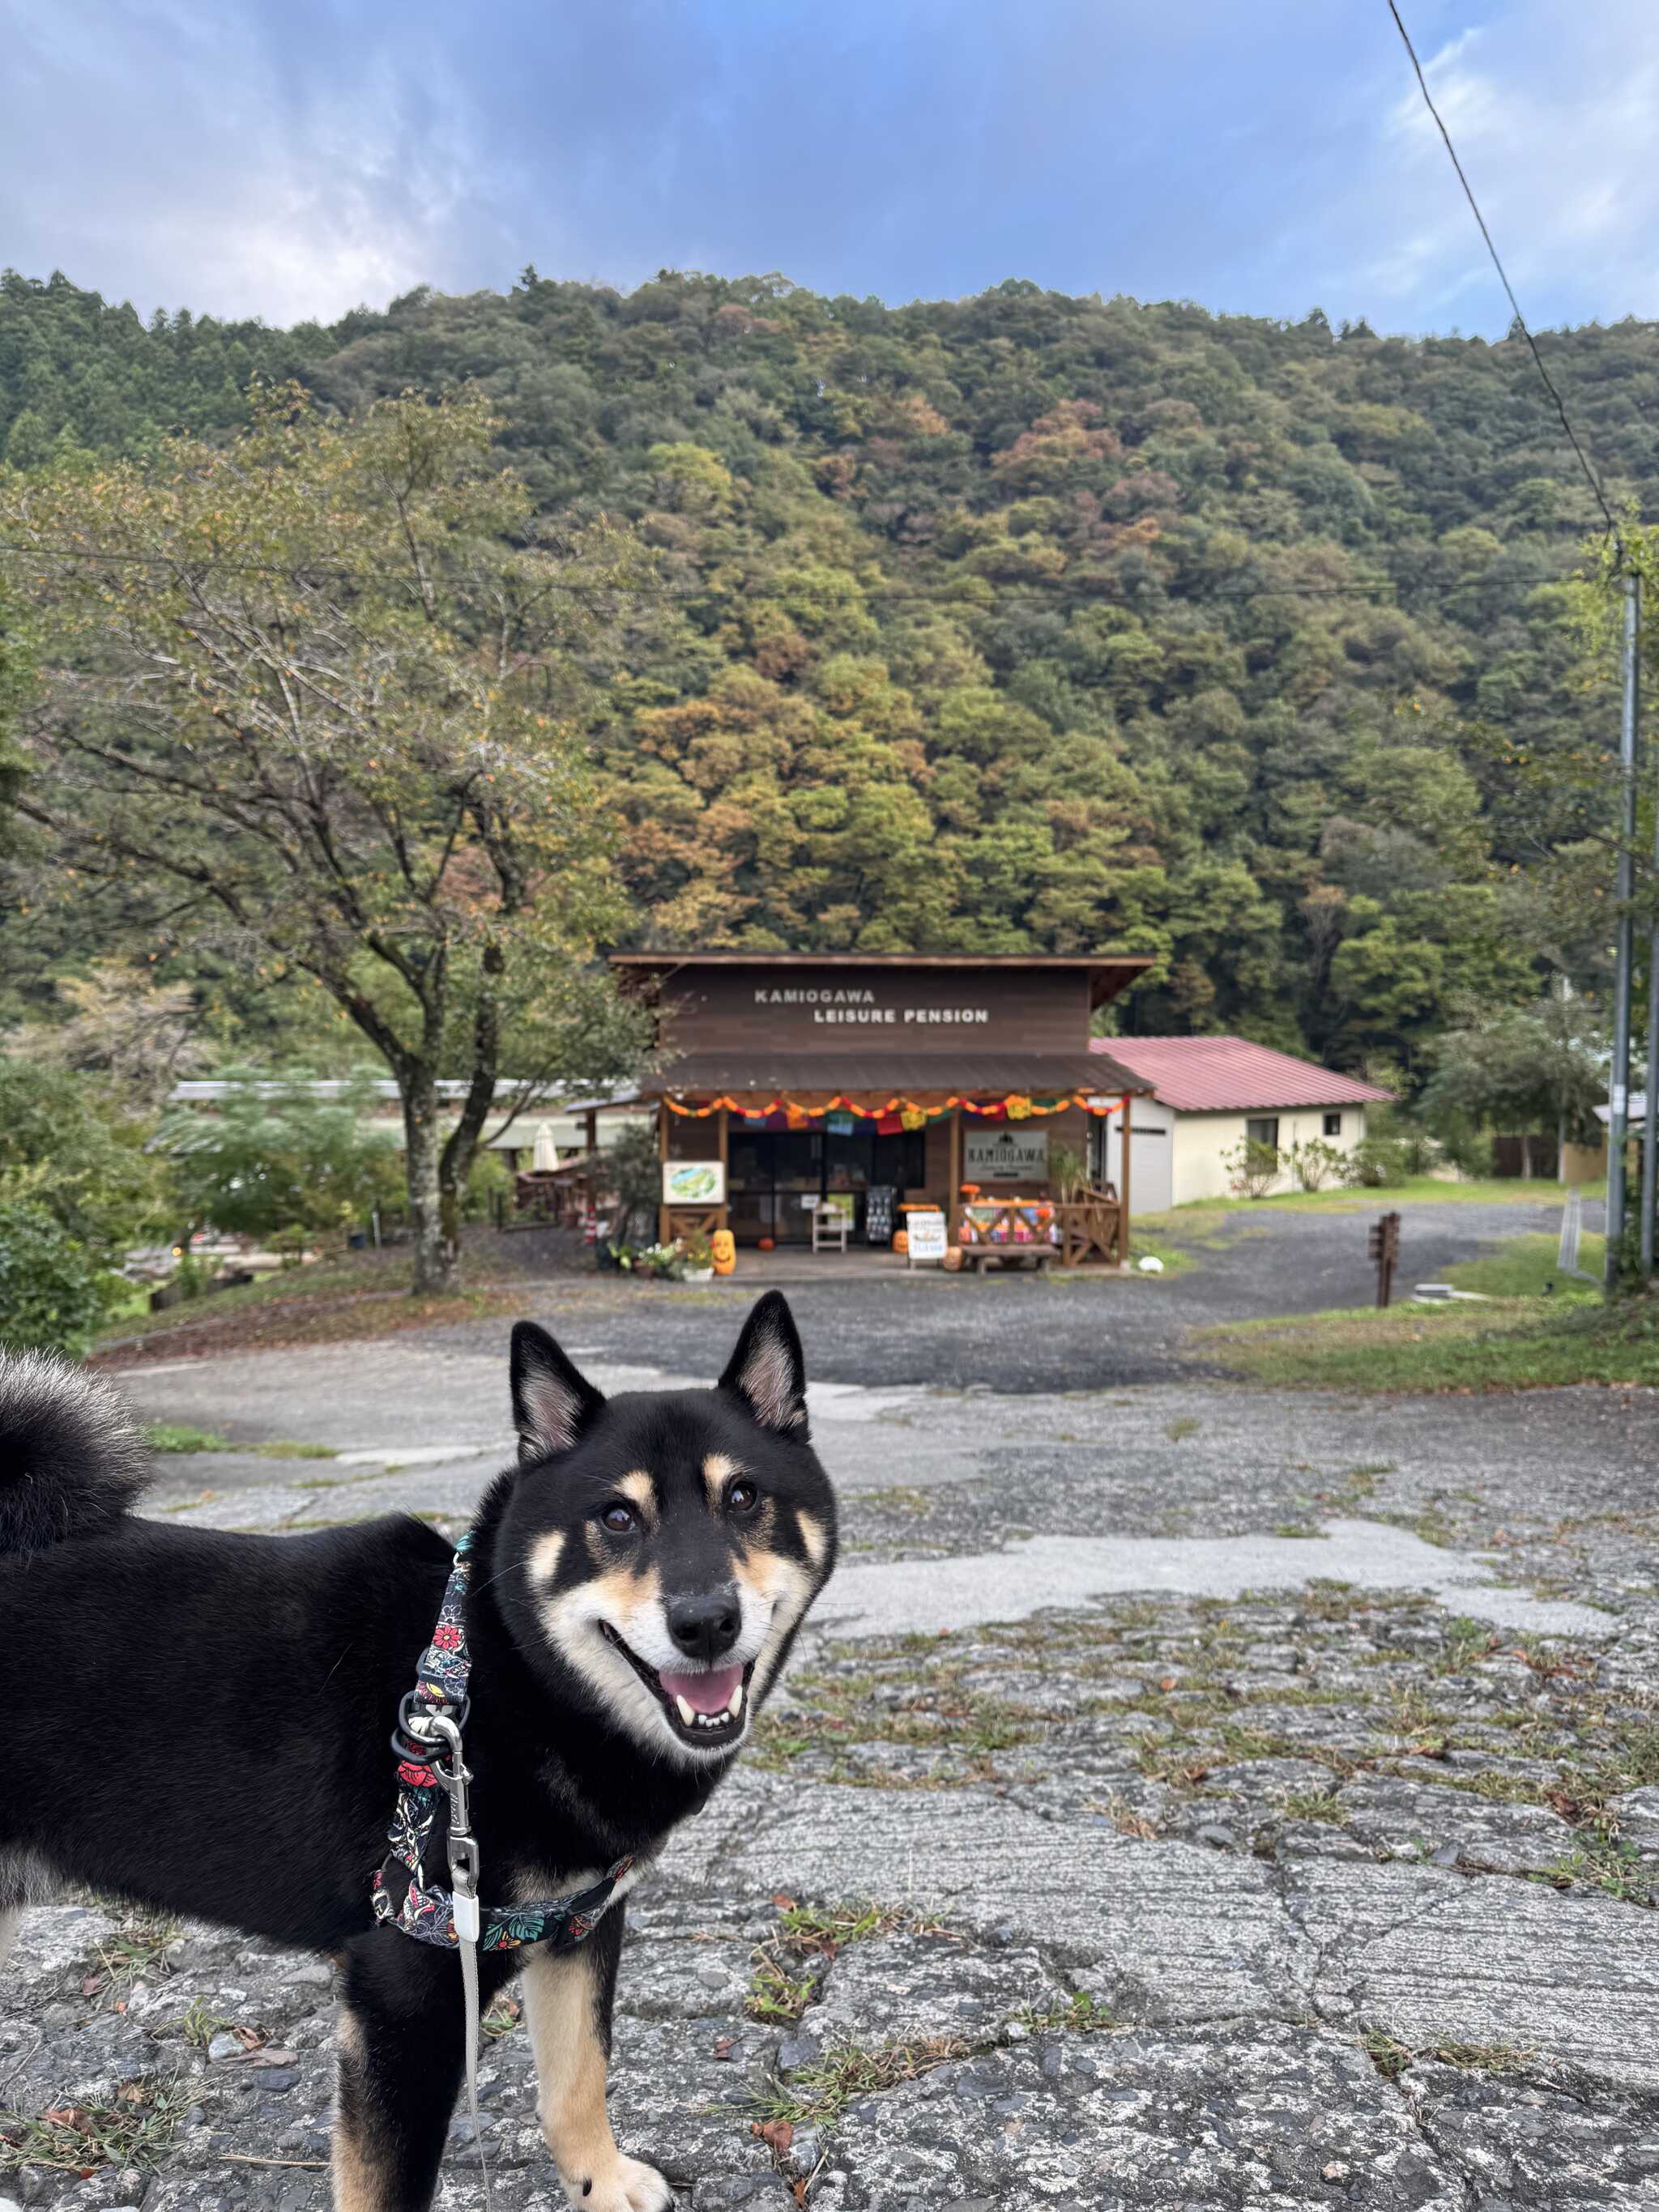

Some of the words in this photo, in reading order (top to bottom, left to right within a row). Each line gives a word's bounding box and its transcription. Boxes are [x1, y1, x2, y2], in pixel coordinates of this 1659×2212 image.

[754, 989, 876, 1004] KAMIOGAWA
[813, 1008, 897, 1023] LEISURE
[904, 1008, 989, 1023] PENSION
[968, 1148, 1044, 1162] KAMIOGAWA
